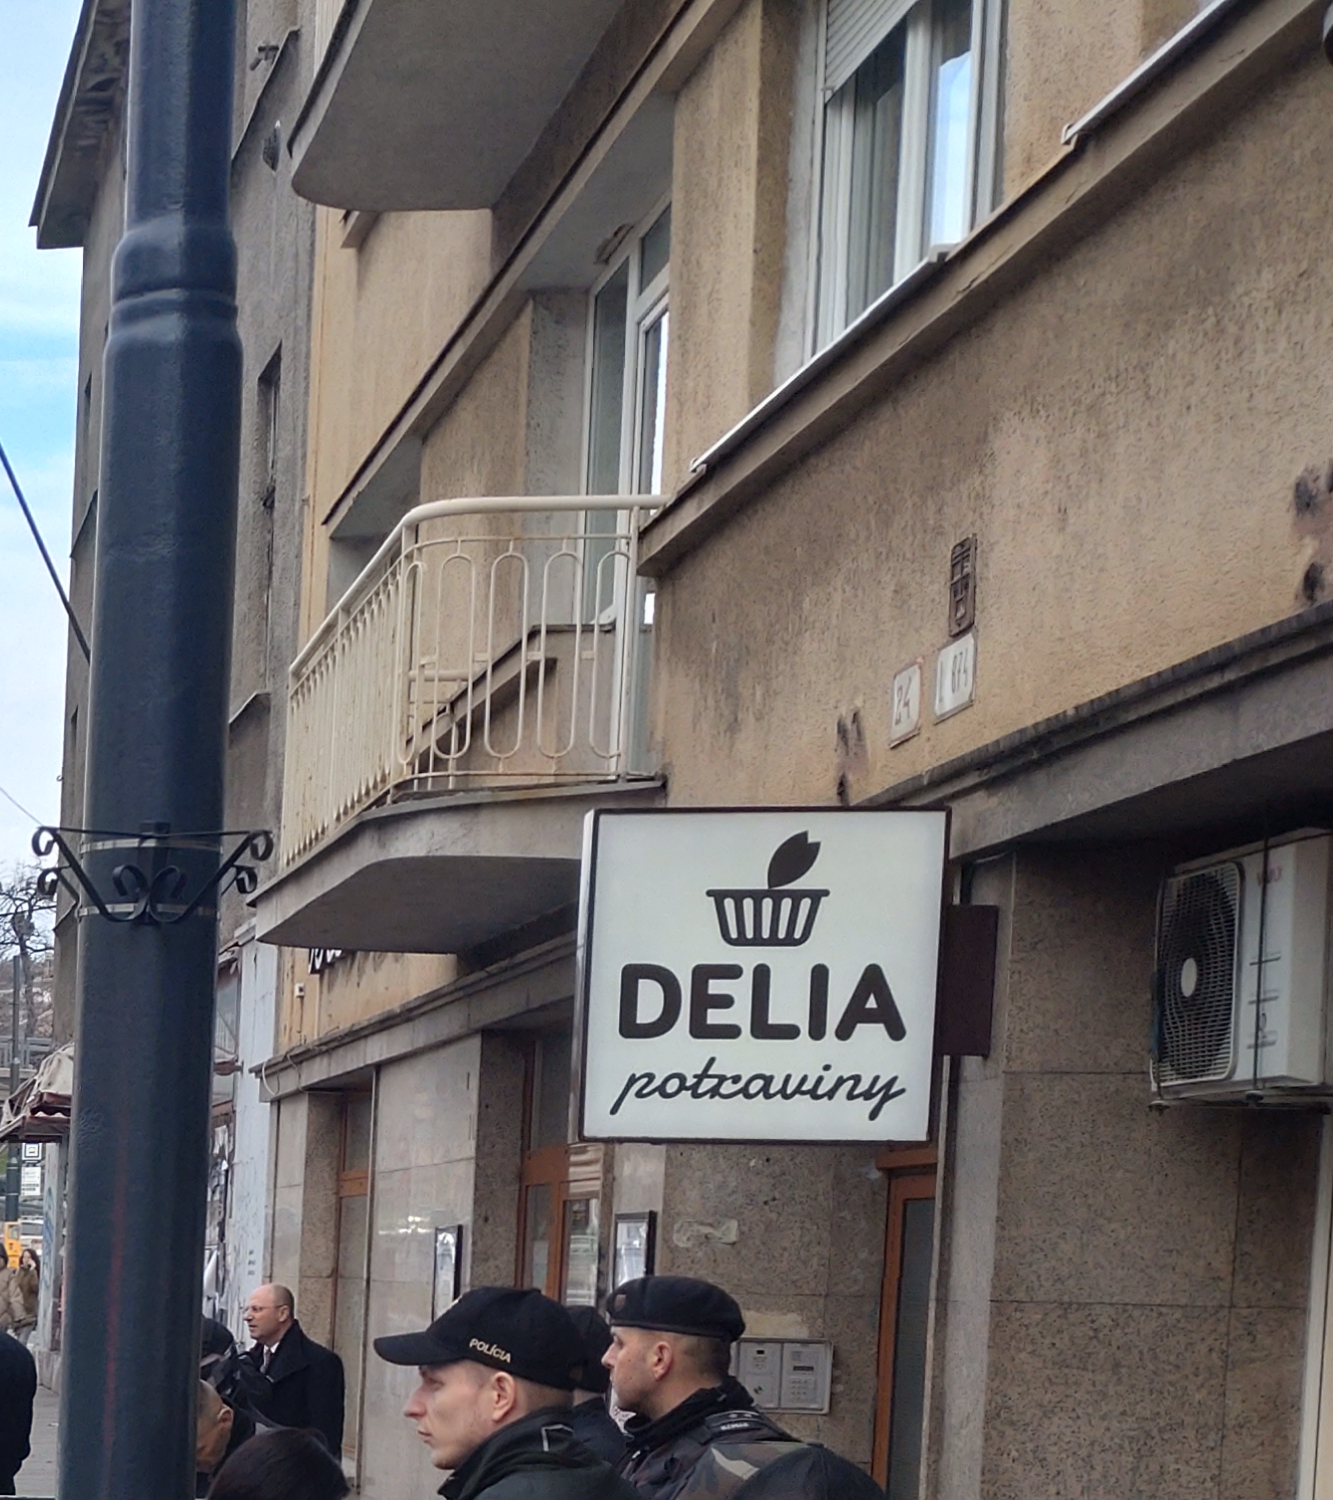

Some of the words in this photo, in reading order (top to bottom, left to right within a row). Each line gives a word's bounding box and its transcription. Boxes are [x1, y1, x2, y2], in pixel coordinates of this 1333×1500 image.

[618, 962, 907, 1042] DELIA
[609, 1056, 907, 1121] potraviny
[469, 1338, 511, 1363] POLÍCIA
